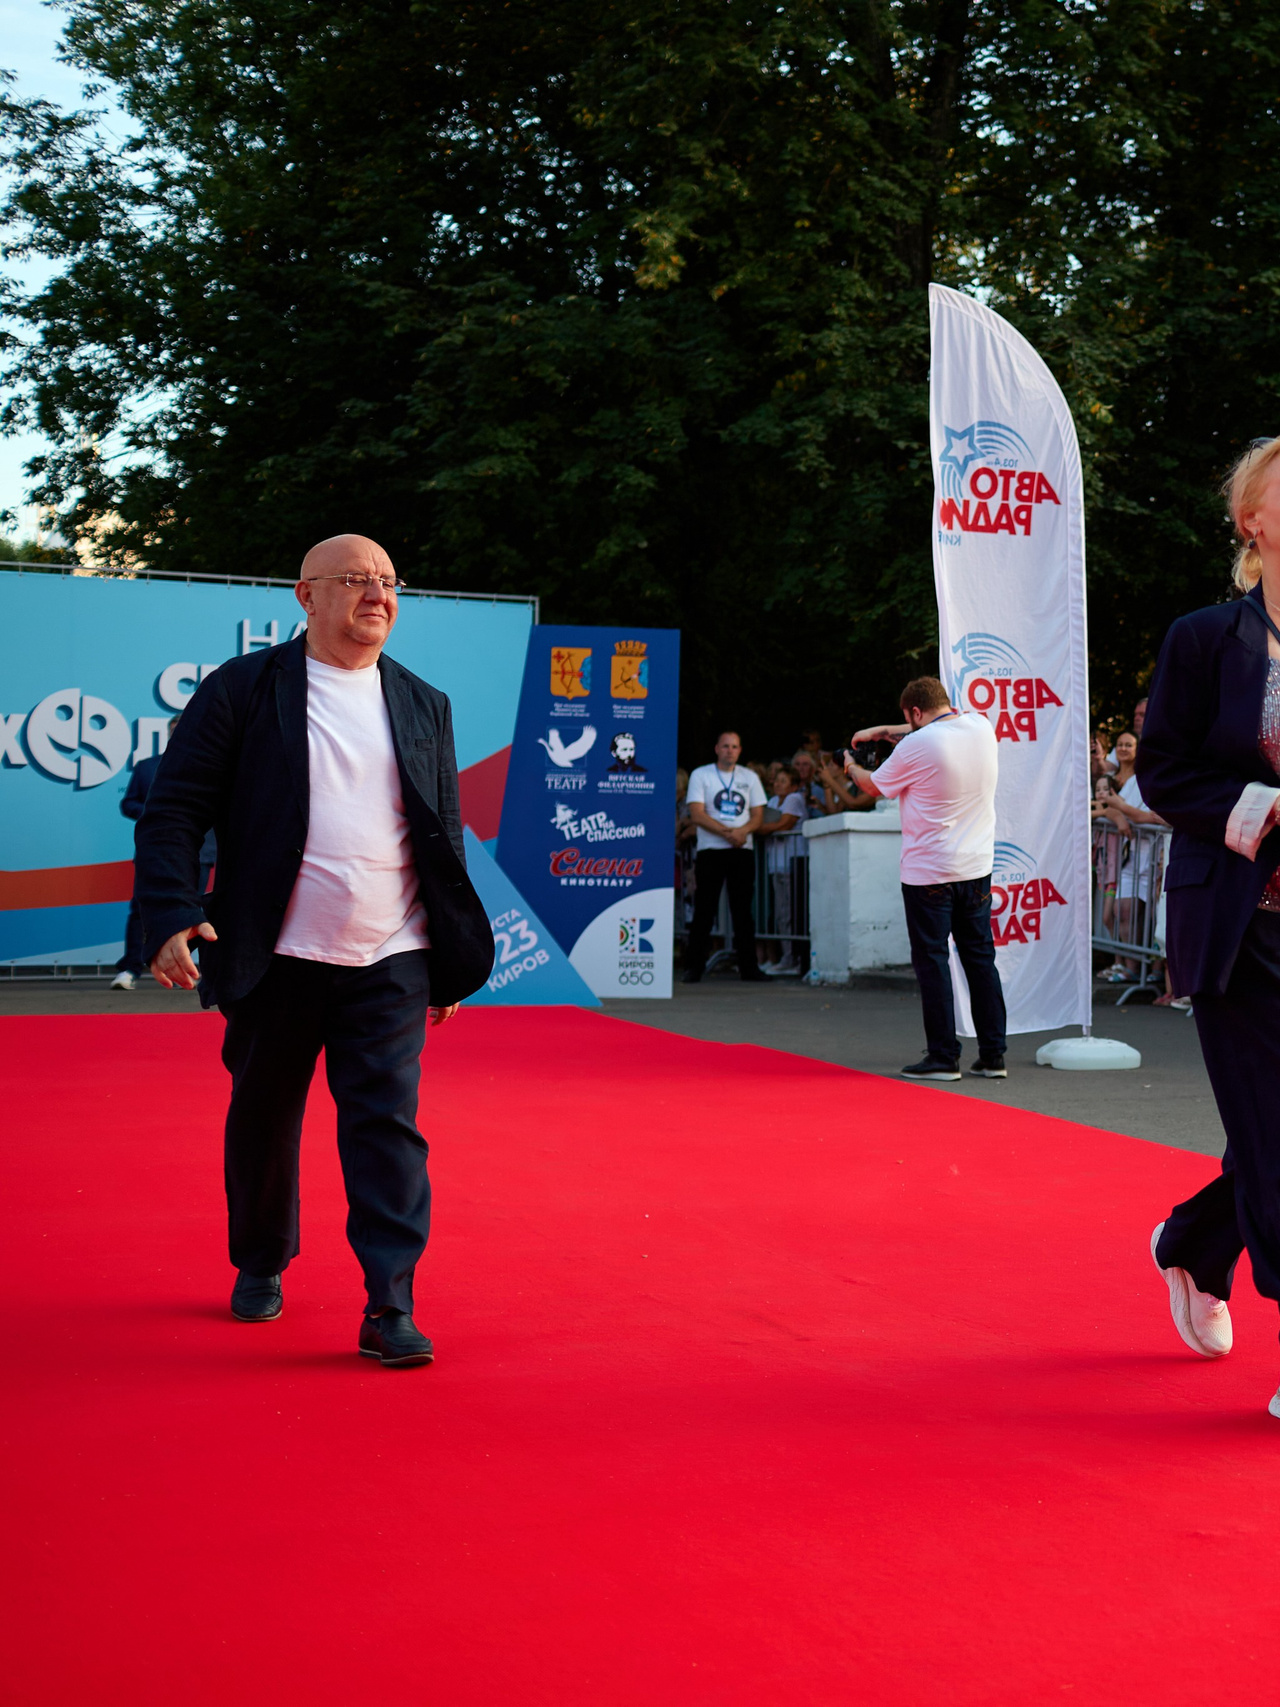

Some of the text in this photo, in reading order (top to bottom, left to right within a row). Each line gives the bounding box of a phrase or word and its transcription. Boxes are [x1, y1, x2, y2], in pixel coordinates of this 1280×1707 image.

[560, 811, 607, 841] ТЕАТР
[587, 822, 645, 842] СПАССКОЙ
[549, 847, 644, 877] Смена
[560, 878, 633, 887] КИНОТЕАТР
[487, 949, 550, 993] КИРОВ
[618, 961, 654, 970] КИРОВ
[618, 971, 655, 986] 650
